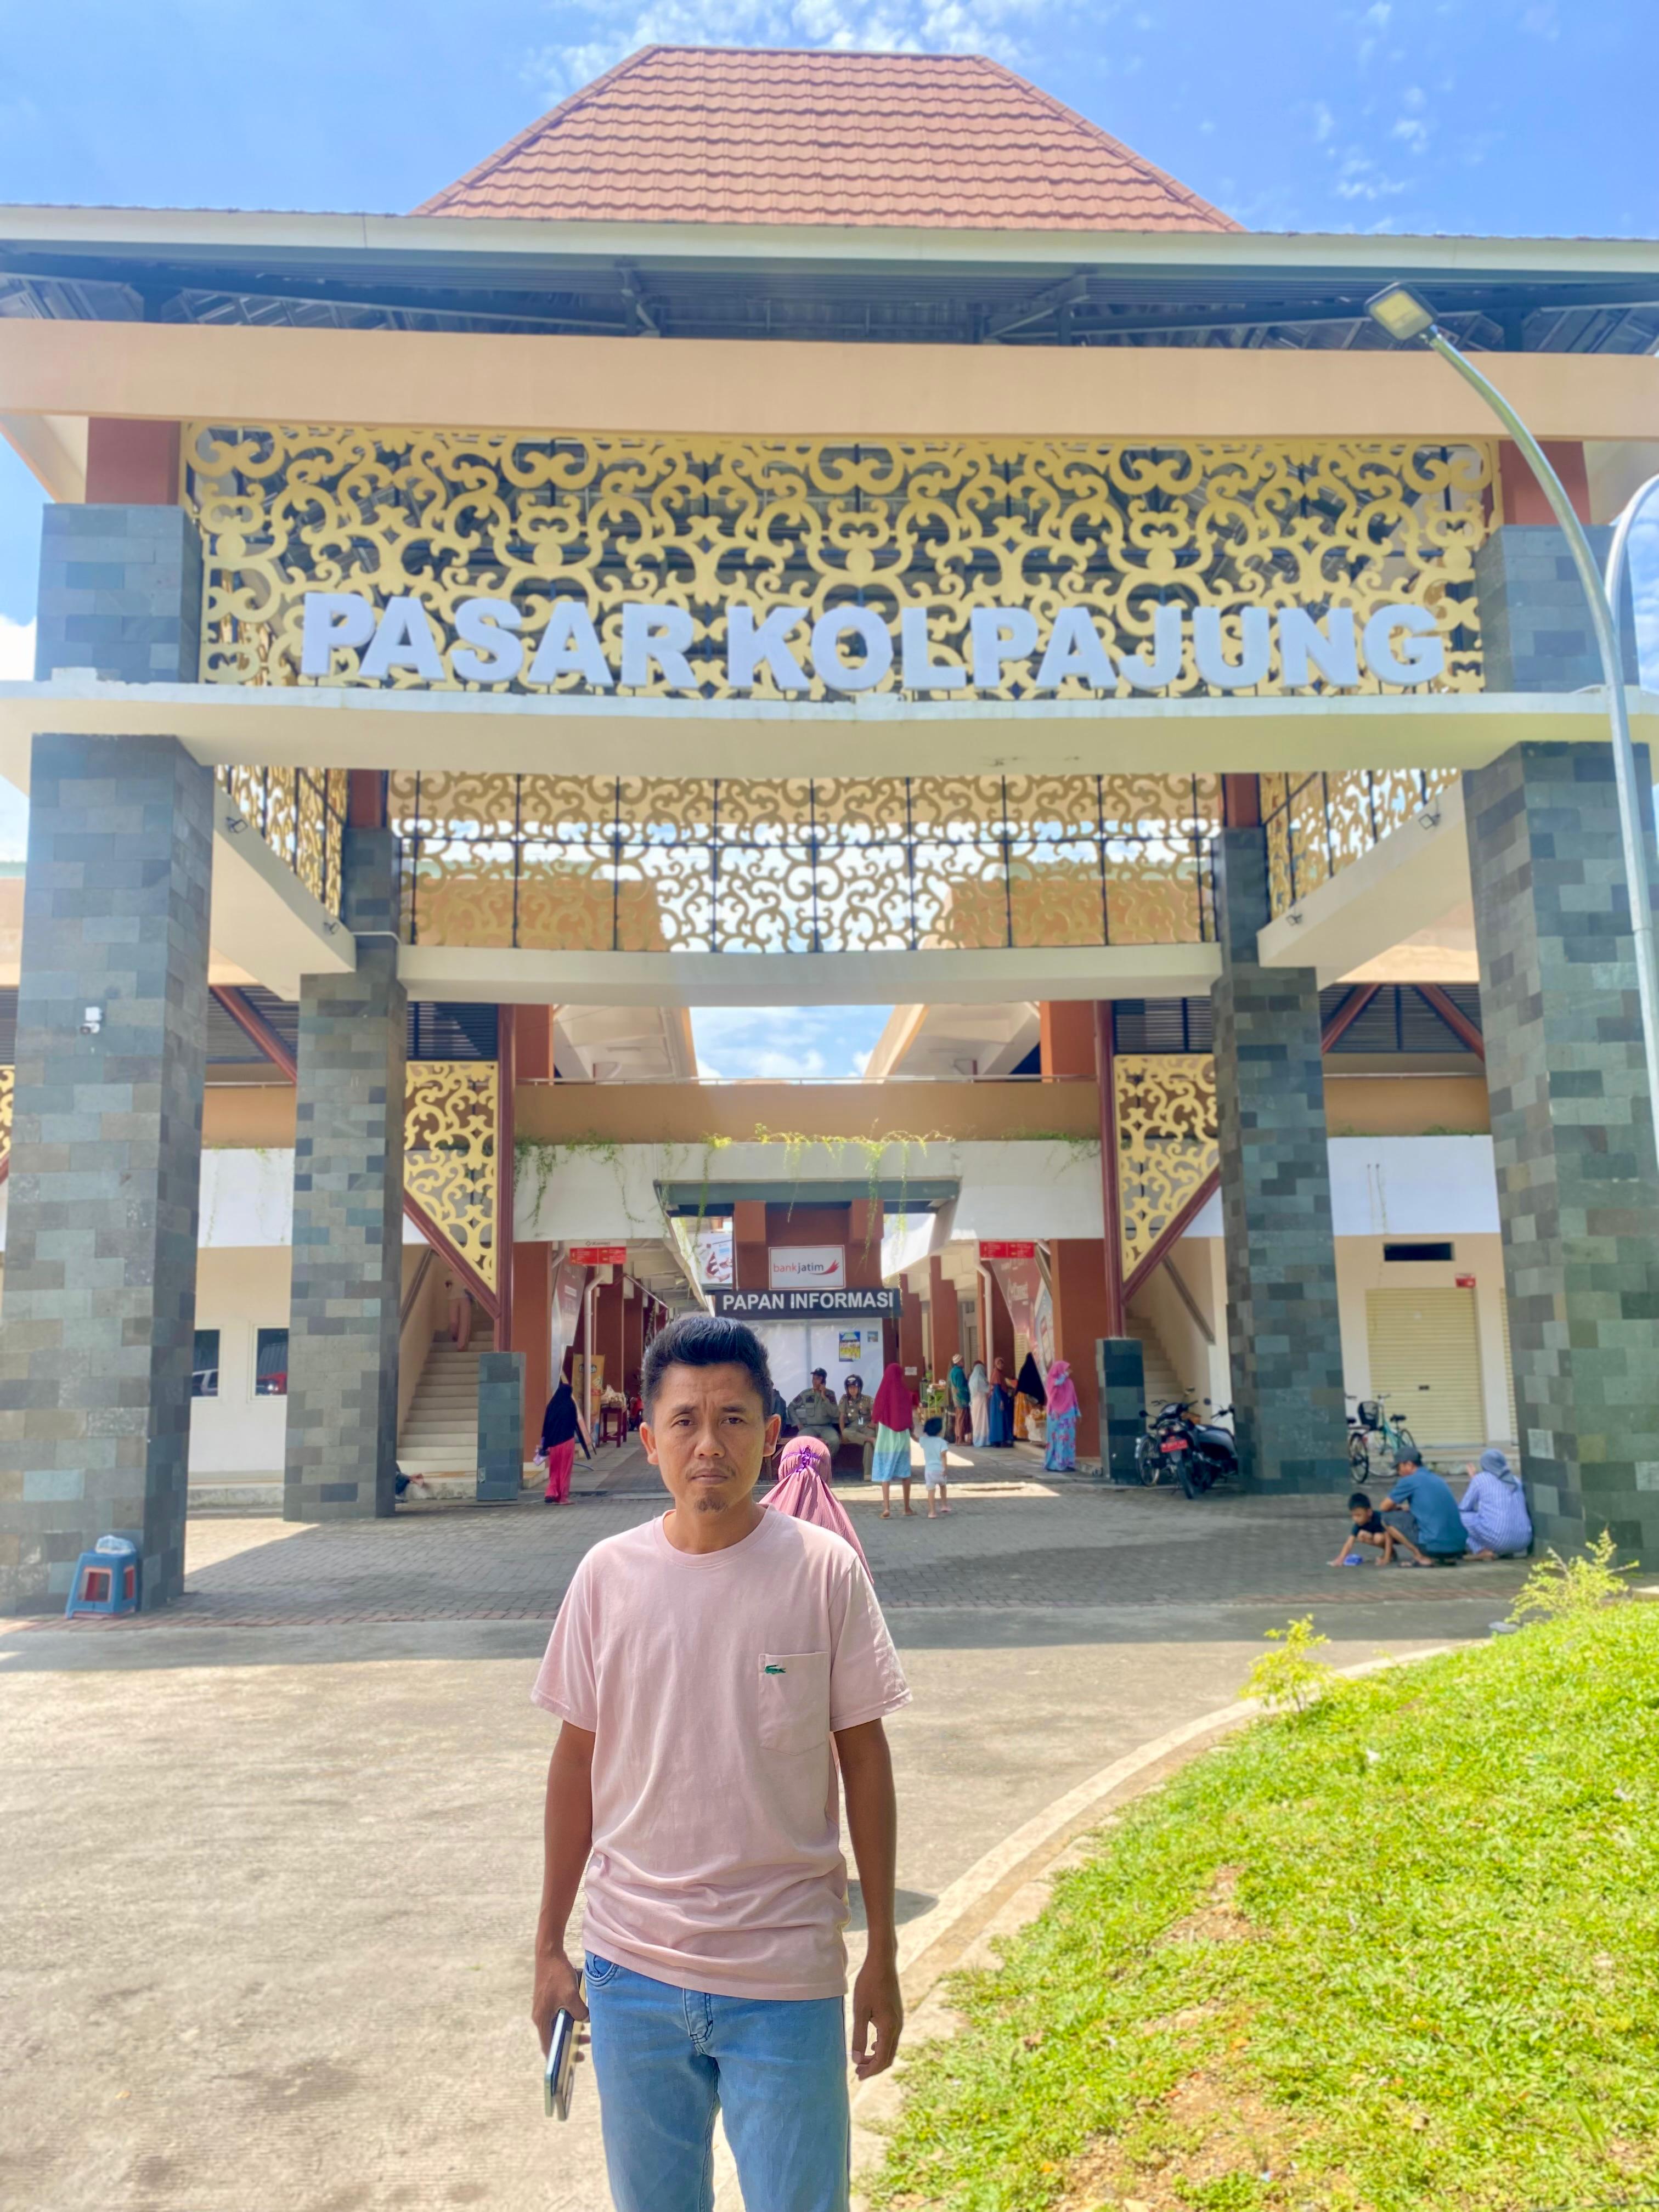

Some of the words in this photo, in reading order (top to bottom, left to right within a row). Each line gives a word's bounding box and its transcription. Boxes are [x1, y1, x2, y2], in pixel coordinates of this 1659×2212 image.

[301, 592, 699, 690] PASAR
[727, 604, 1444, 691] KOLPAJUNG
[723, 1293, 784, 1310] PAPAN
[791, 1291, 893, 1310] INFORMASI
